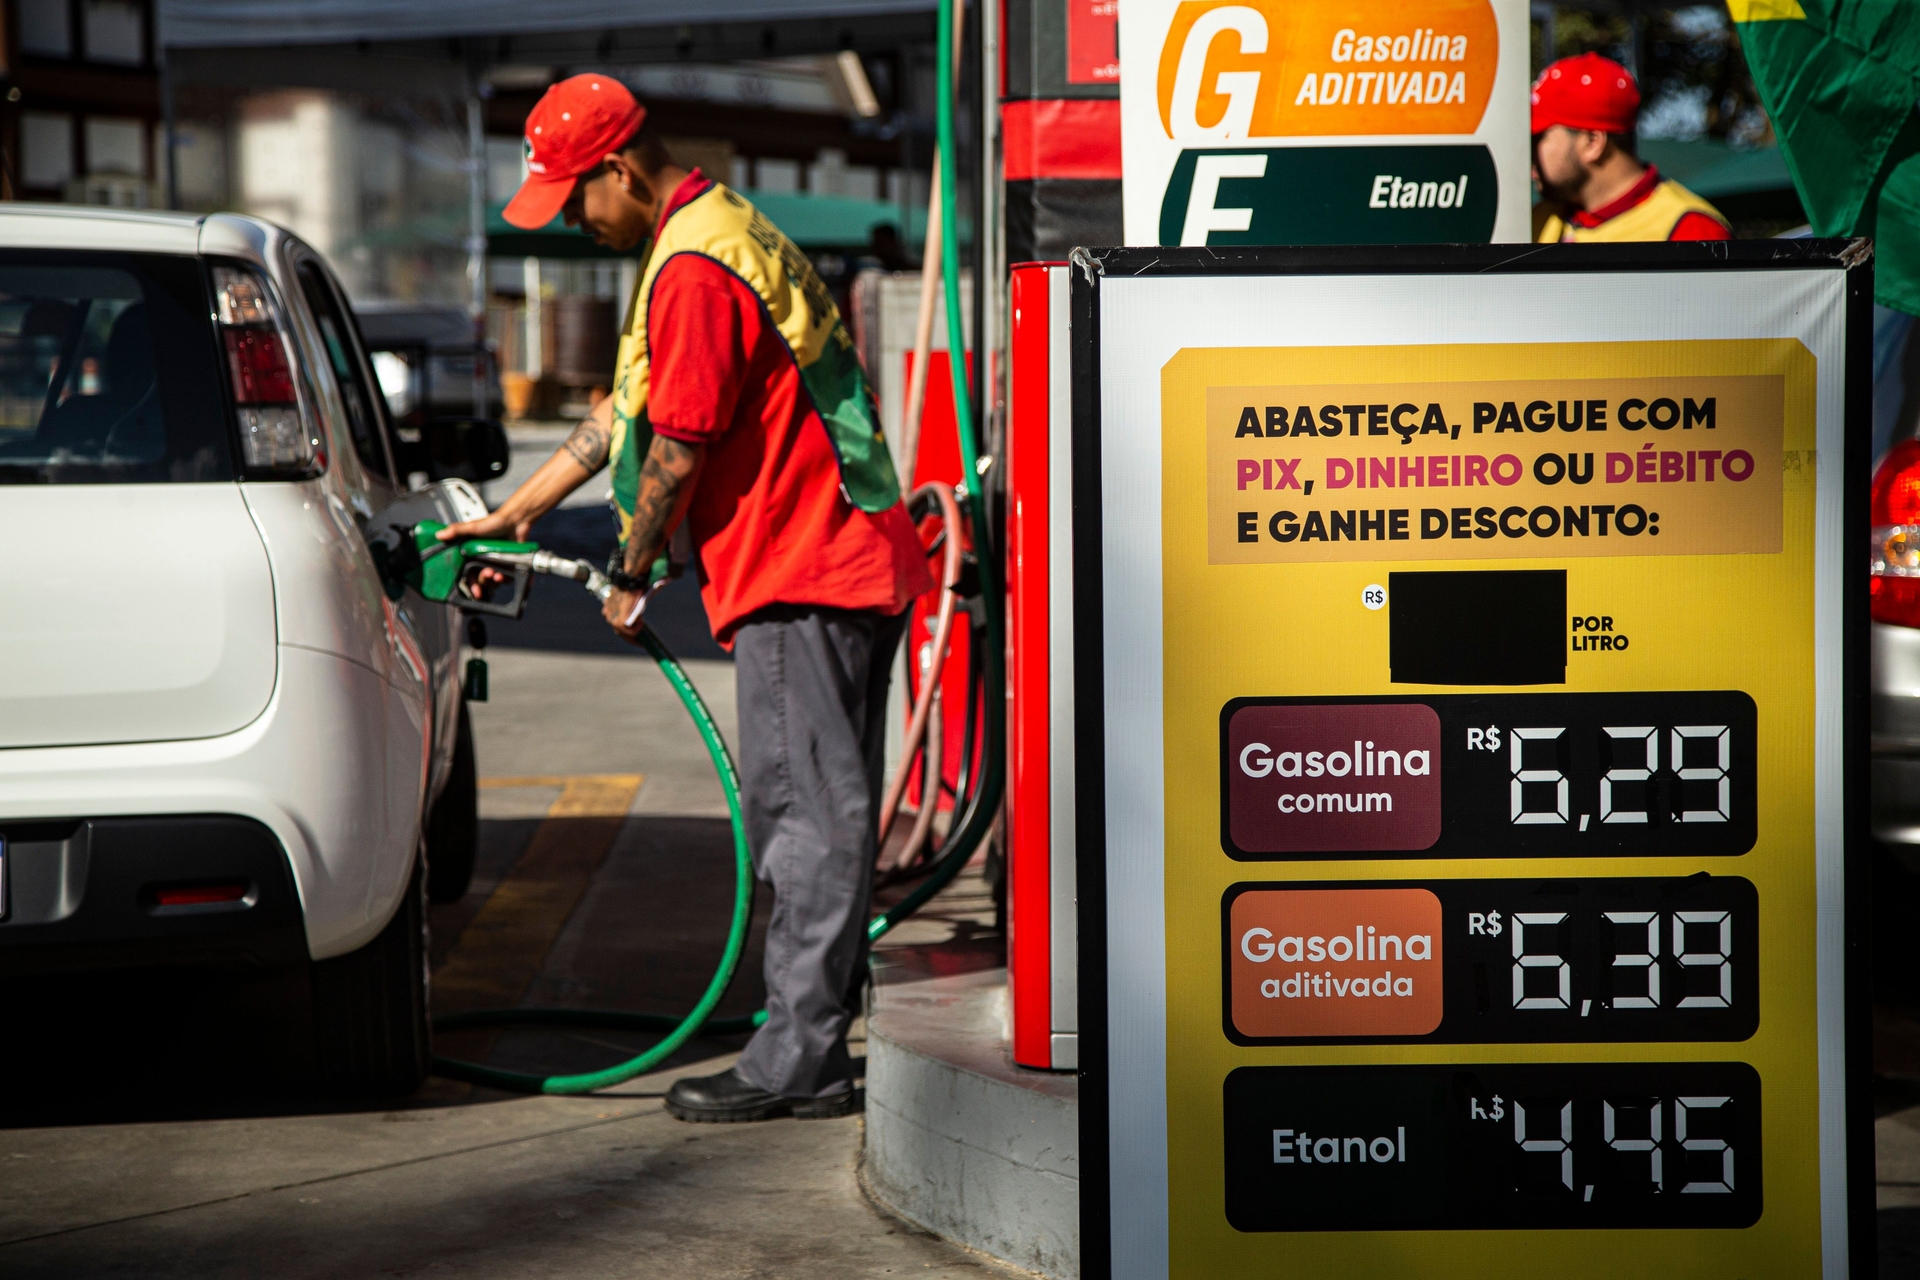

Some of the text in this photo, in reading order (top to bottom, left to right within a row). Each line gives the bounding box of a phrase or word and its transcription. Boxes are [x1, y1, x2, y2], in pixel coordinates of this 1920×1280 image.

[1331, 28, 1468, 63] Gasolina
[1295, 71, 1466, 106] ADITIVADA
[1369, 175, 1468, 208] Etanol
[1235, 397, 1717, 445] ABASTEÇA, PAGUE COM
[1237, 443, 1756, 495] PIX, DINHEIRO OU DÉBITO
[1237, 503, 1660, 543] E GANHE DESCONTO:
[1364, 590, 1384, 605] R$
[1572, 615, 1614, 632] POR
[1572, 634, 1630, 652] LITRO
[1239, 740, 1431, 779] Gasolina
[1467, 724, 1731, 832] R$ 6,29
[1277, 789, 1393, 814] comum
[1241, 925, 1432, 963] Gasolina
[1468, 909, 1732, 1017] R$ 6,39
[1260, 971, 1414, 999] aditivada
[1272, 1126, 1406, 1164] Etanol
[1513, 1096, 1735, 1202] 4,45
